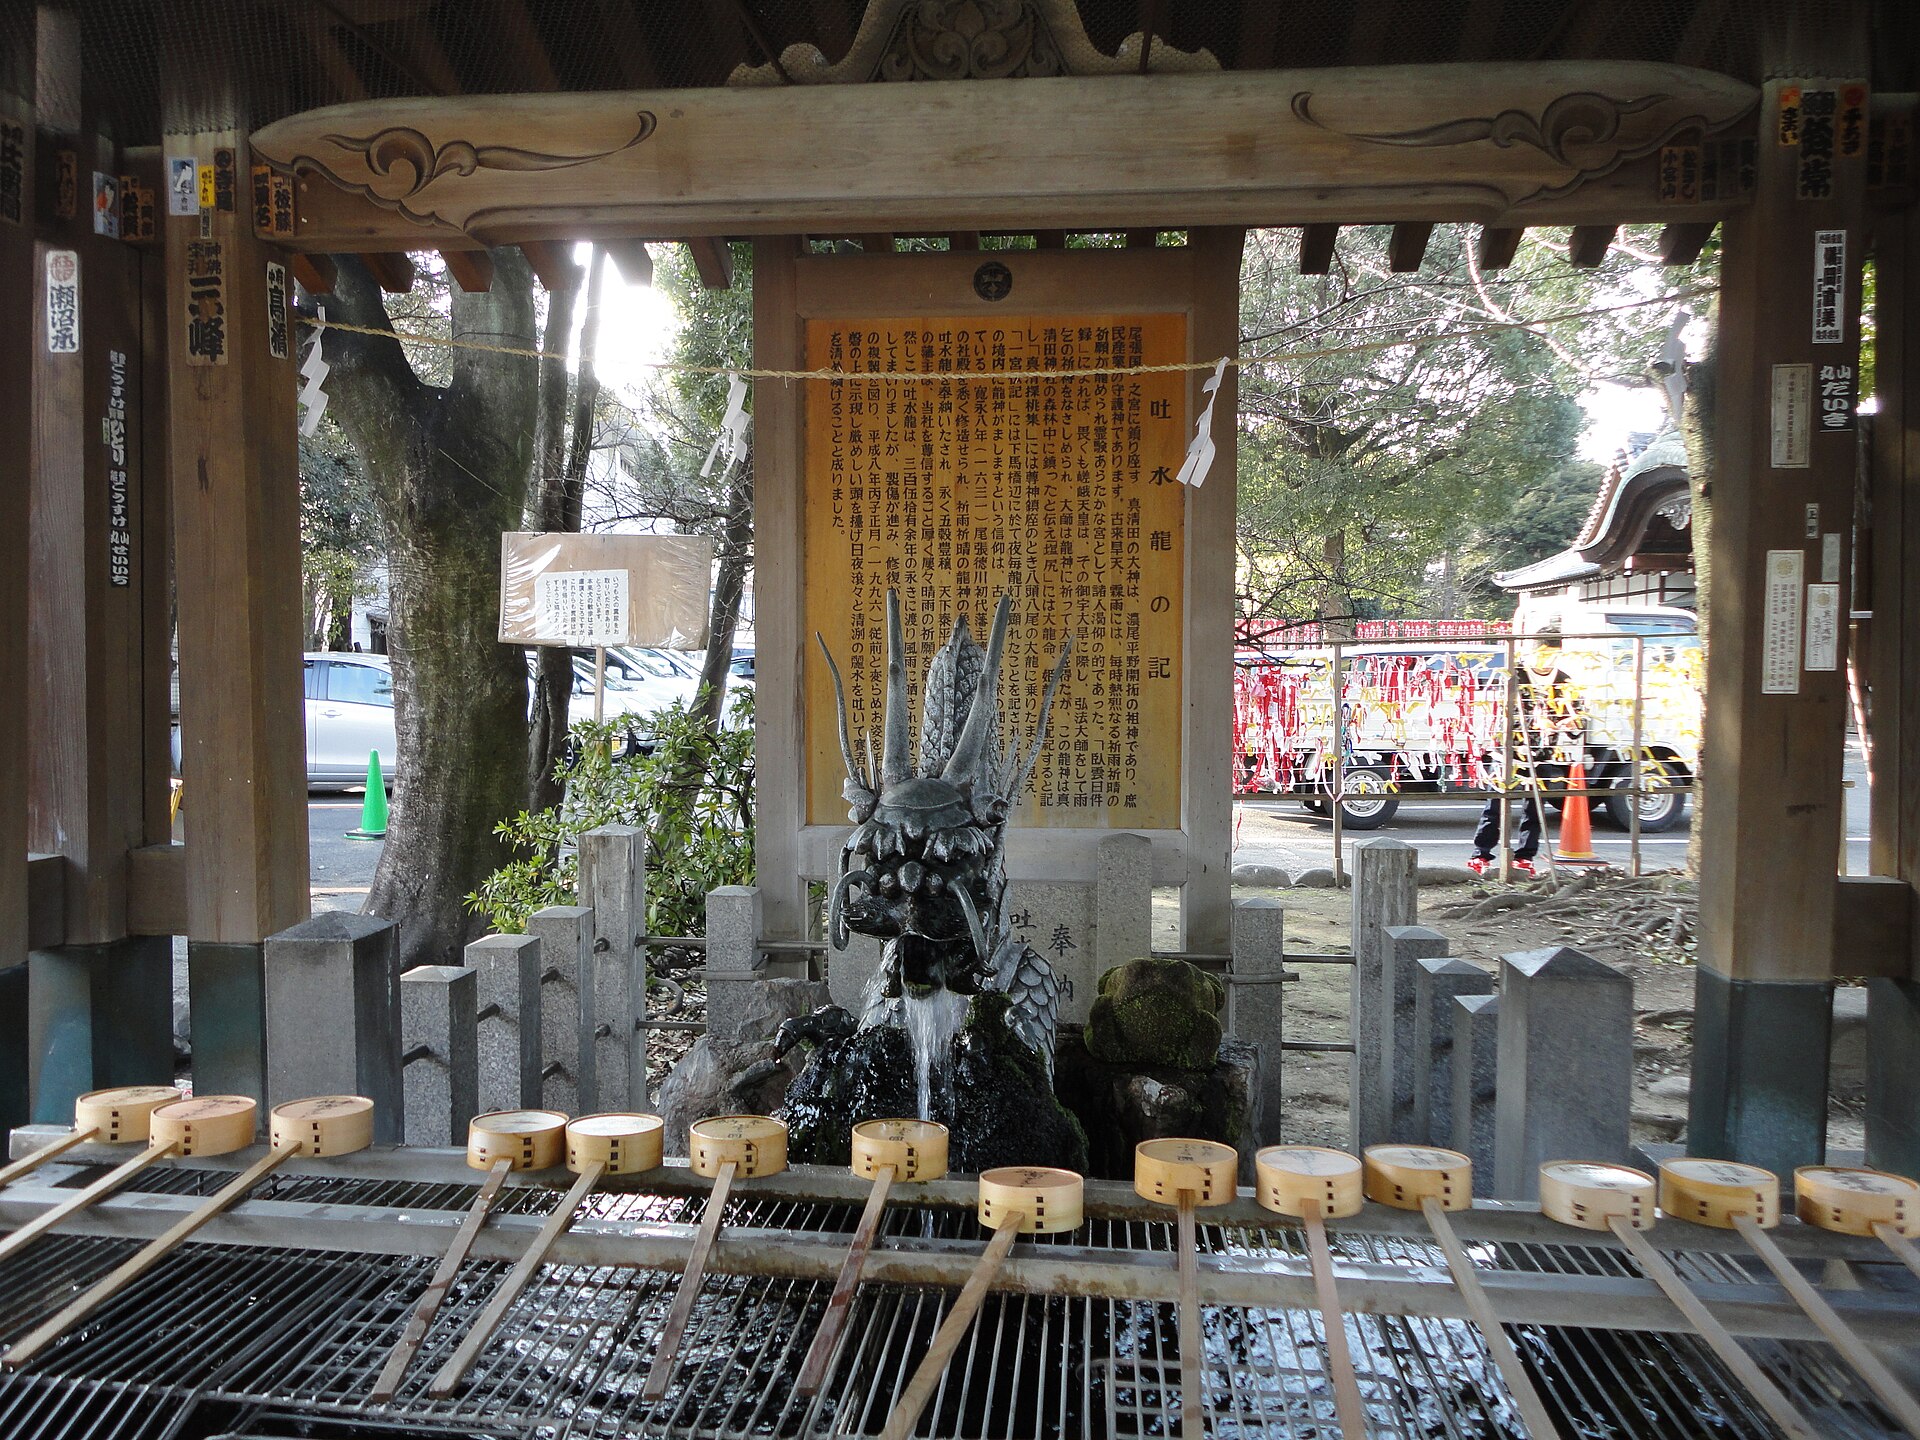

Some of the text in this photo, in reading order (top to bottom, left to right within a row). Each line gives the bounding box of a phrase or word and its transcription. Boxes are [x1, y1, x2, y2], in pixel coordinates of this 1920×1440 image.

[1147, 398, 1173, 680] 吐水龍の記
